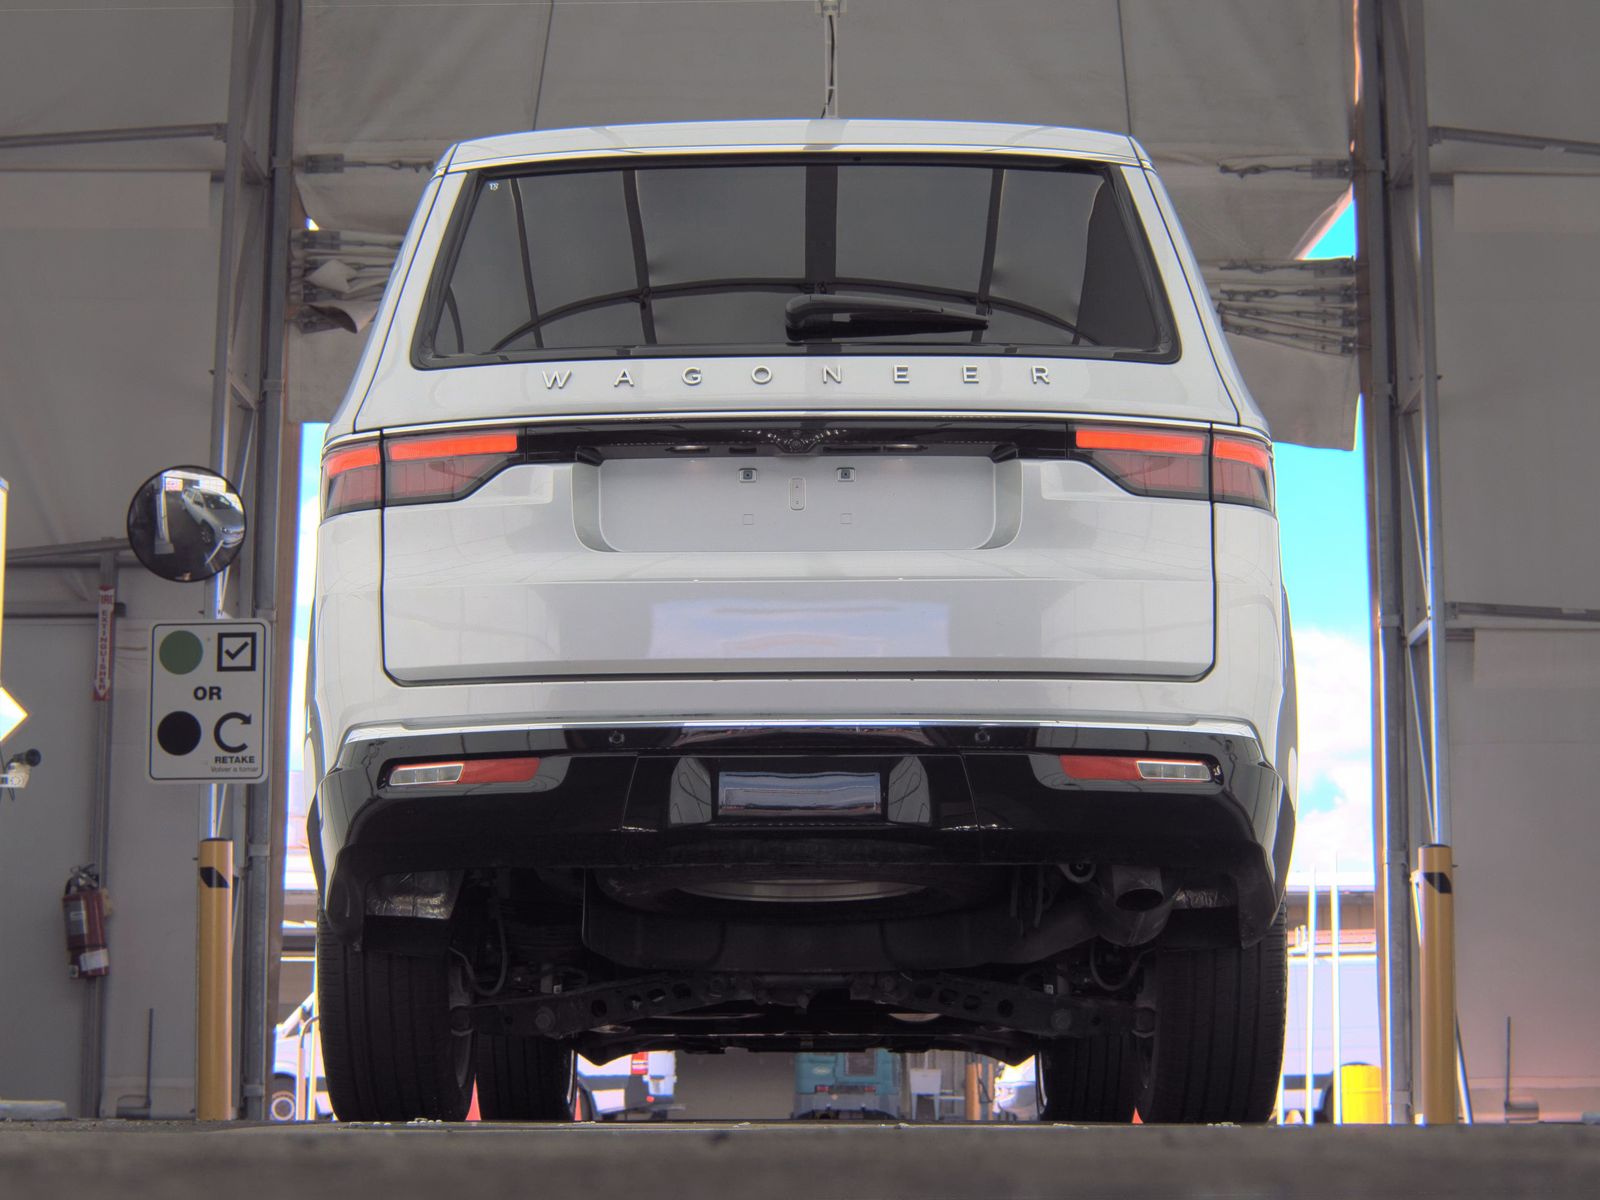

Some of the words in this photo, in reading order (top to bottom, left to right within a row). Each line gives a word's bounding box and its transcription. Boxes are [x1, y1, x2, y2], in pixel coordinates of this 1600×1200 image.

[542, 366, 1051, 389] WAGONEER
[98, 610, 108, 689] EXTINGUISHER
[193, 686, 222, 701] OR
[214, 756, 255, 764] RETAKE
